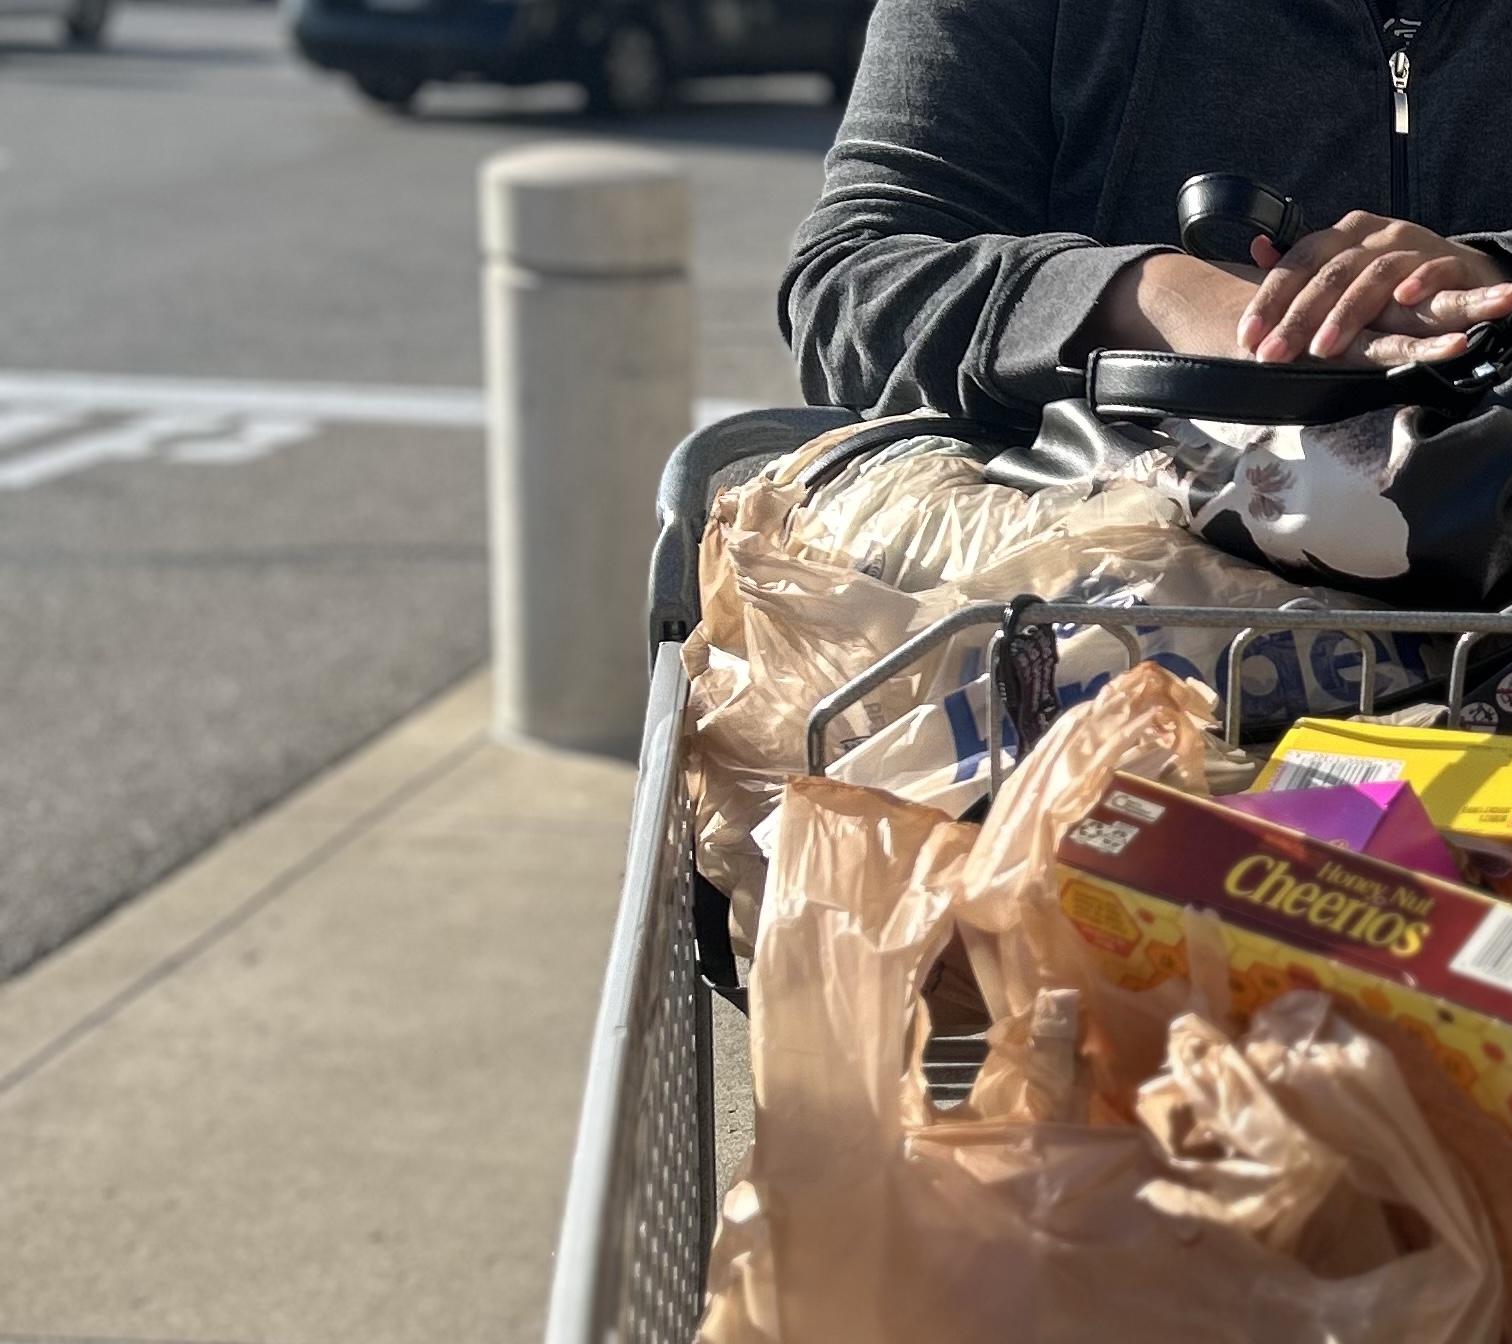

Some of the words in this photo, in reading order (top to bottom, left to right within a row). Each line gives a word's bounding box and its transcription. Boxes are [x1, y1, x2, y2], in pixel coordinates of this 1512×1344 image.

[1224, 853, 1432, 958] Cheerios
[1316, 861, 1389, 903] Honey
[1391, 886, 1436, 915] Nut
